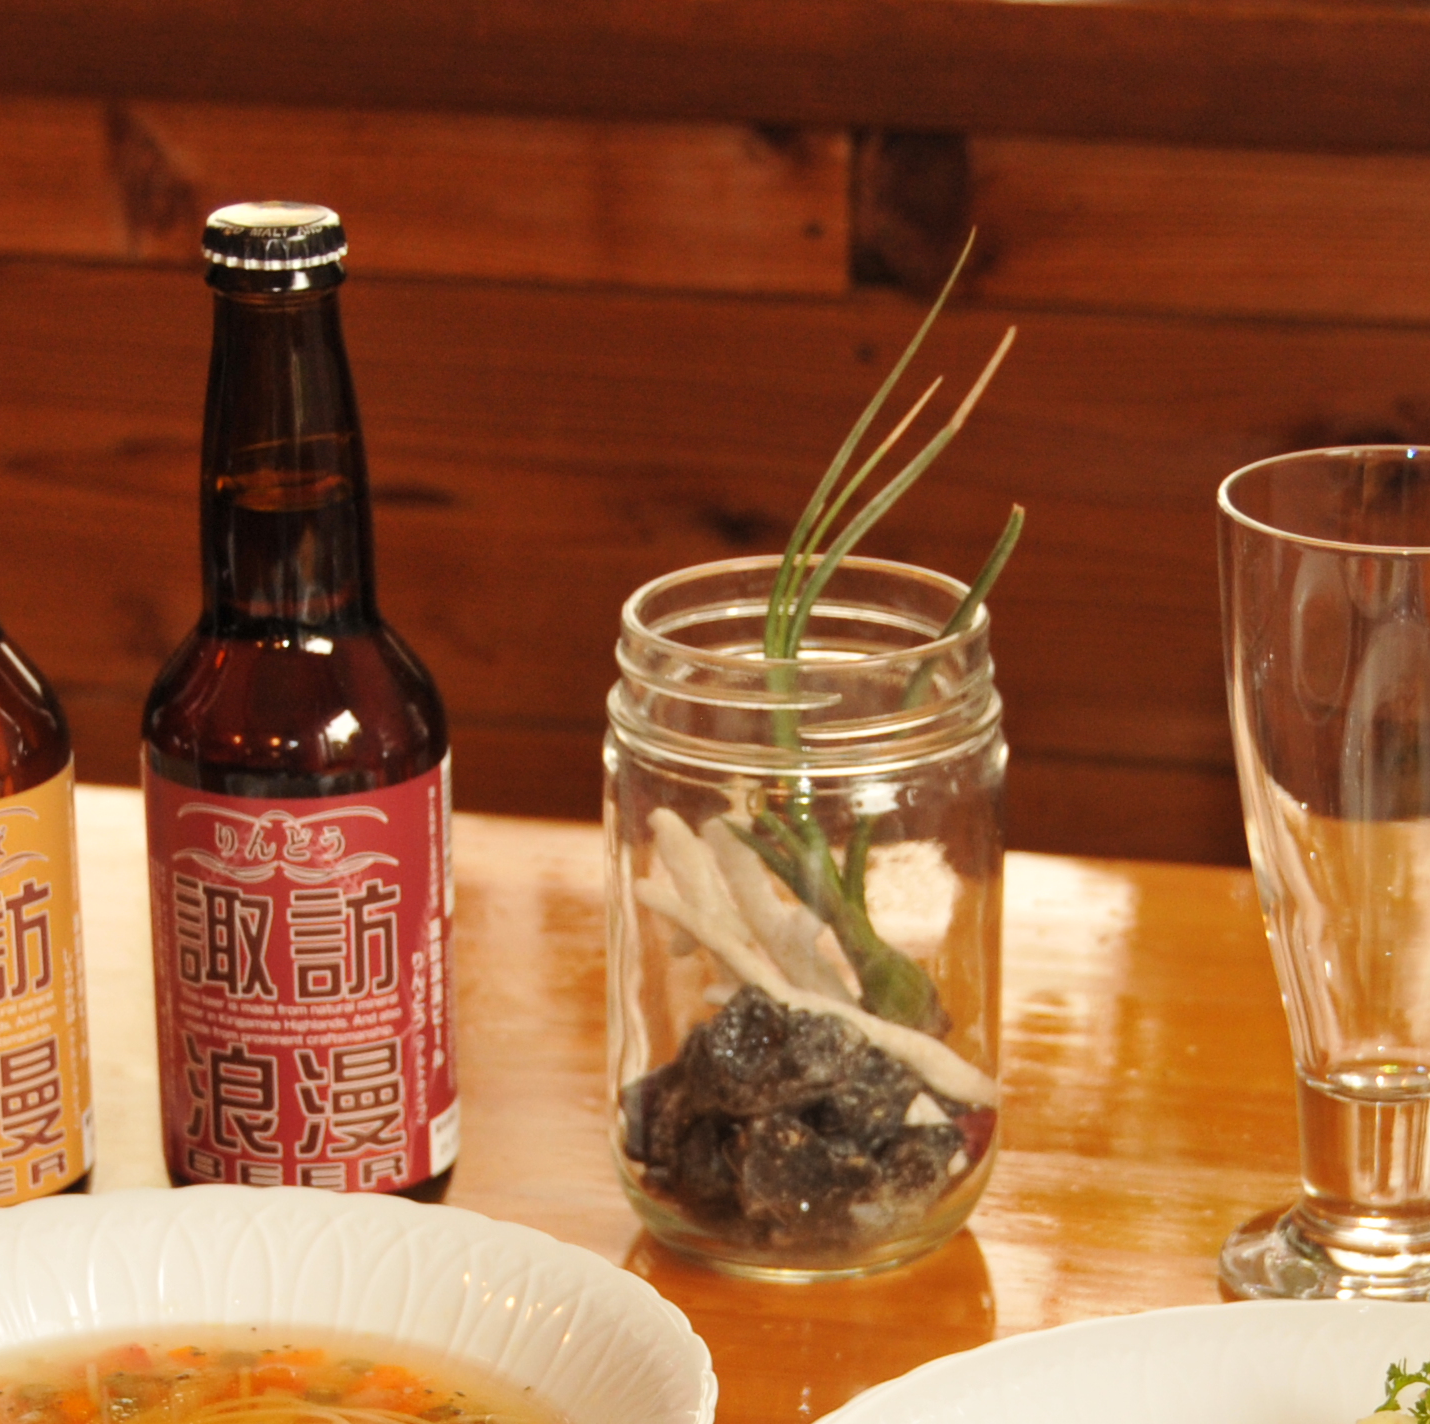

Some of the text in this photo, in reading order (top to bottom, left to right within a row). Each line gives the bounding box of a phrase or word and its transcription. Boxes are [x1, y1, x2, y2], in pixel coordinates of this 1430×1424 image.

[215, 821, 345, 862] りんどう
[173, 871, 400, 1001] 諏訪
[183, 1030, 407, 1159] 浪漫
[185, 1150, 408, 1192] BEER
